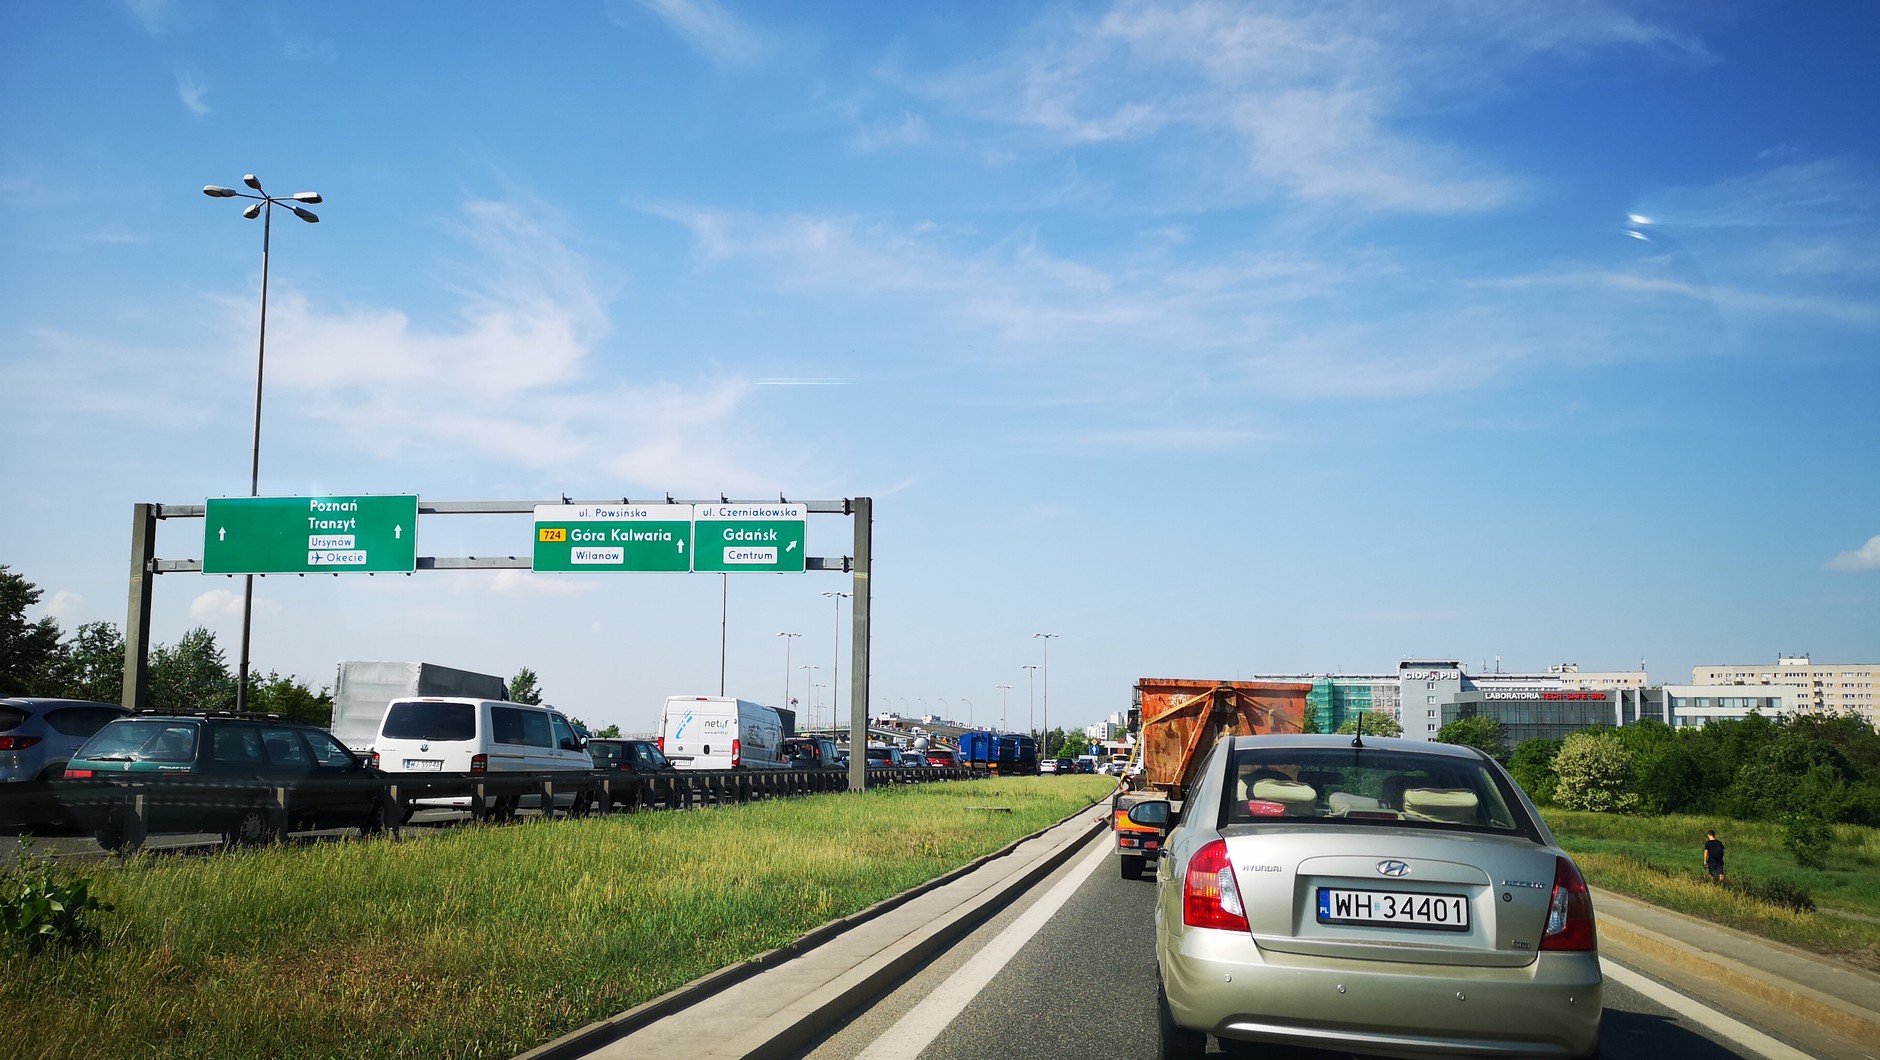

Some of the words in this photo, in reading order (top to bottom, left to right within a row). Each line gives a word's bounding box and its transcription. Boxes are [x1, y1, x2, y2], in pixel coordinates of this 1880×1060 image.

[309, 499, 358, 512] Poznań
[578, 508, 594, 518] ul.
[595, 508, 648, 518] Powsińska
[702, 507, 716, 517] ul.
[718, 507, 798, 517] Czerniakowska
[308, 517, 355, 532] Tranzyt
[543, 530, 561, 540] 724
[570, 528, 606, 542] Góra
[611, 528, 672, 542] Kalwaria
[722, 528, 778, 542] Gdańsk
[311, 537, 352, 548] Ursynów
[575, 550, 620, 561] Wilanów
[728, 550, 773, 561] Centrum
[1405, 671, 1429, 680] CIOP
[1440, 672, 1459, 680] PIB
[1485, 692, 1540, 700] LABORATORIA
[1243, 865, 1282, 873] HYUNDAI
[1320, 906, 1329, 914] PL
[1335, 893, 1372, 918] WH
[1383, 895, 1461, 924] 34401
